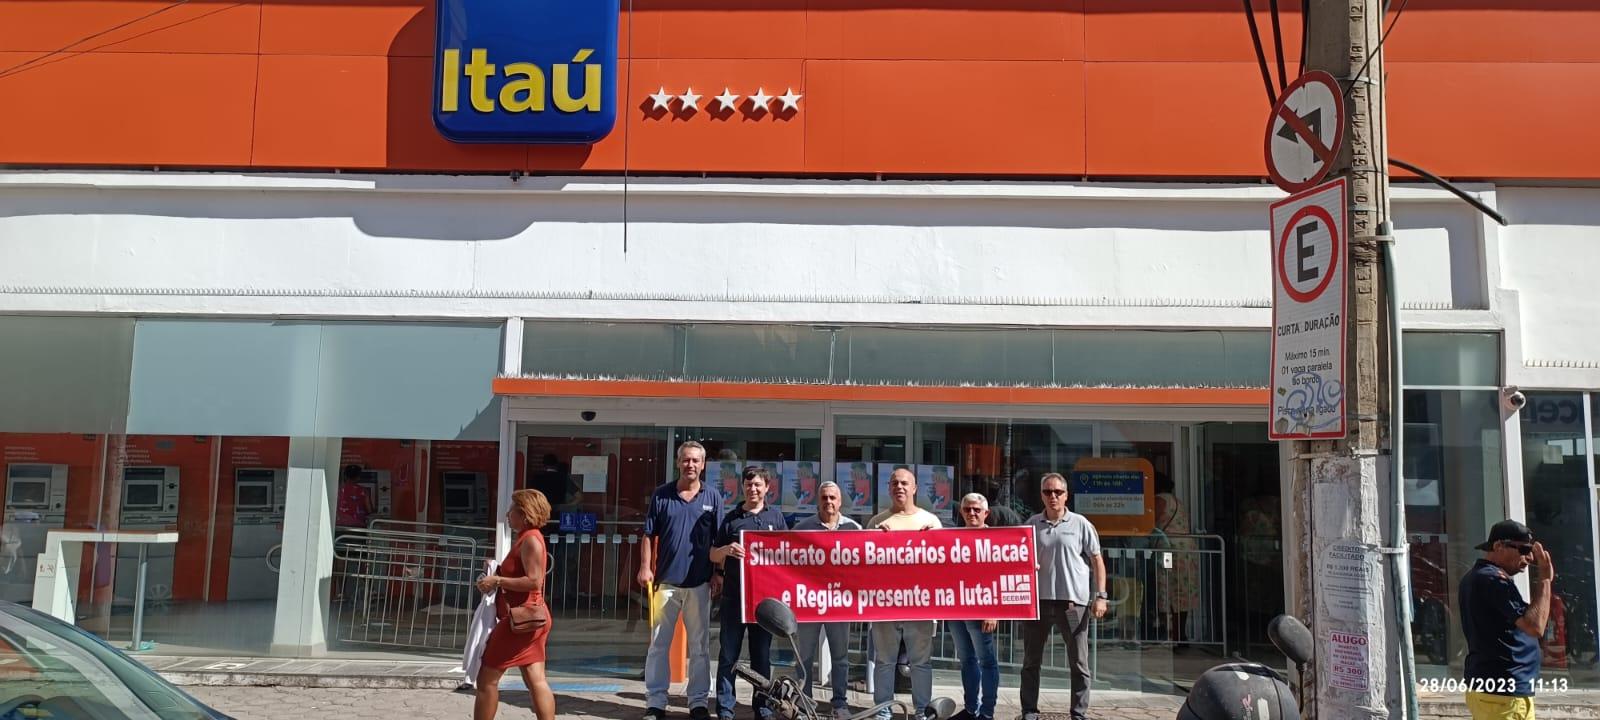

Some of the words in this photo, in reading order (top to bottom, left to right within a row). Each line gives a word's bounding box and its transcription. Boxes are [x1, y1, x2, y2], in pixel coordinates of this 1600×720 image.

[441, 48, 601, 113] Itaú
[1296, 220, 1319, 283] E
[1277, 322, 1300, 337] CURTA
[1304, 313, 1340, 331] DURAÇÃO
[1281, 365, 1289, 375] 01
[1307, 361, 1333, 373] paralela
[1285, 351, 1308, 361] Máximo
[1310, 348, 1317, 358] 15
[749, 541, 826, 566] Sindicato
[830, 540, 860, 565] dos
[864, 539, 946, 565] Bancários
[950, 537, 971, 563] de
[975, 536, 1029, 563] Macaé
[796, 582, 853, 615] Região
[857, 584, 931, 615] presente
[934, 588, 956, 607] na
[959, 580, 999, 606] luta!
[1331, 634, 1367, 646] ALUGO
